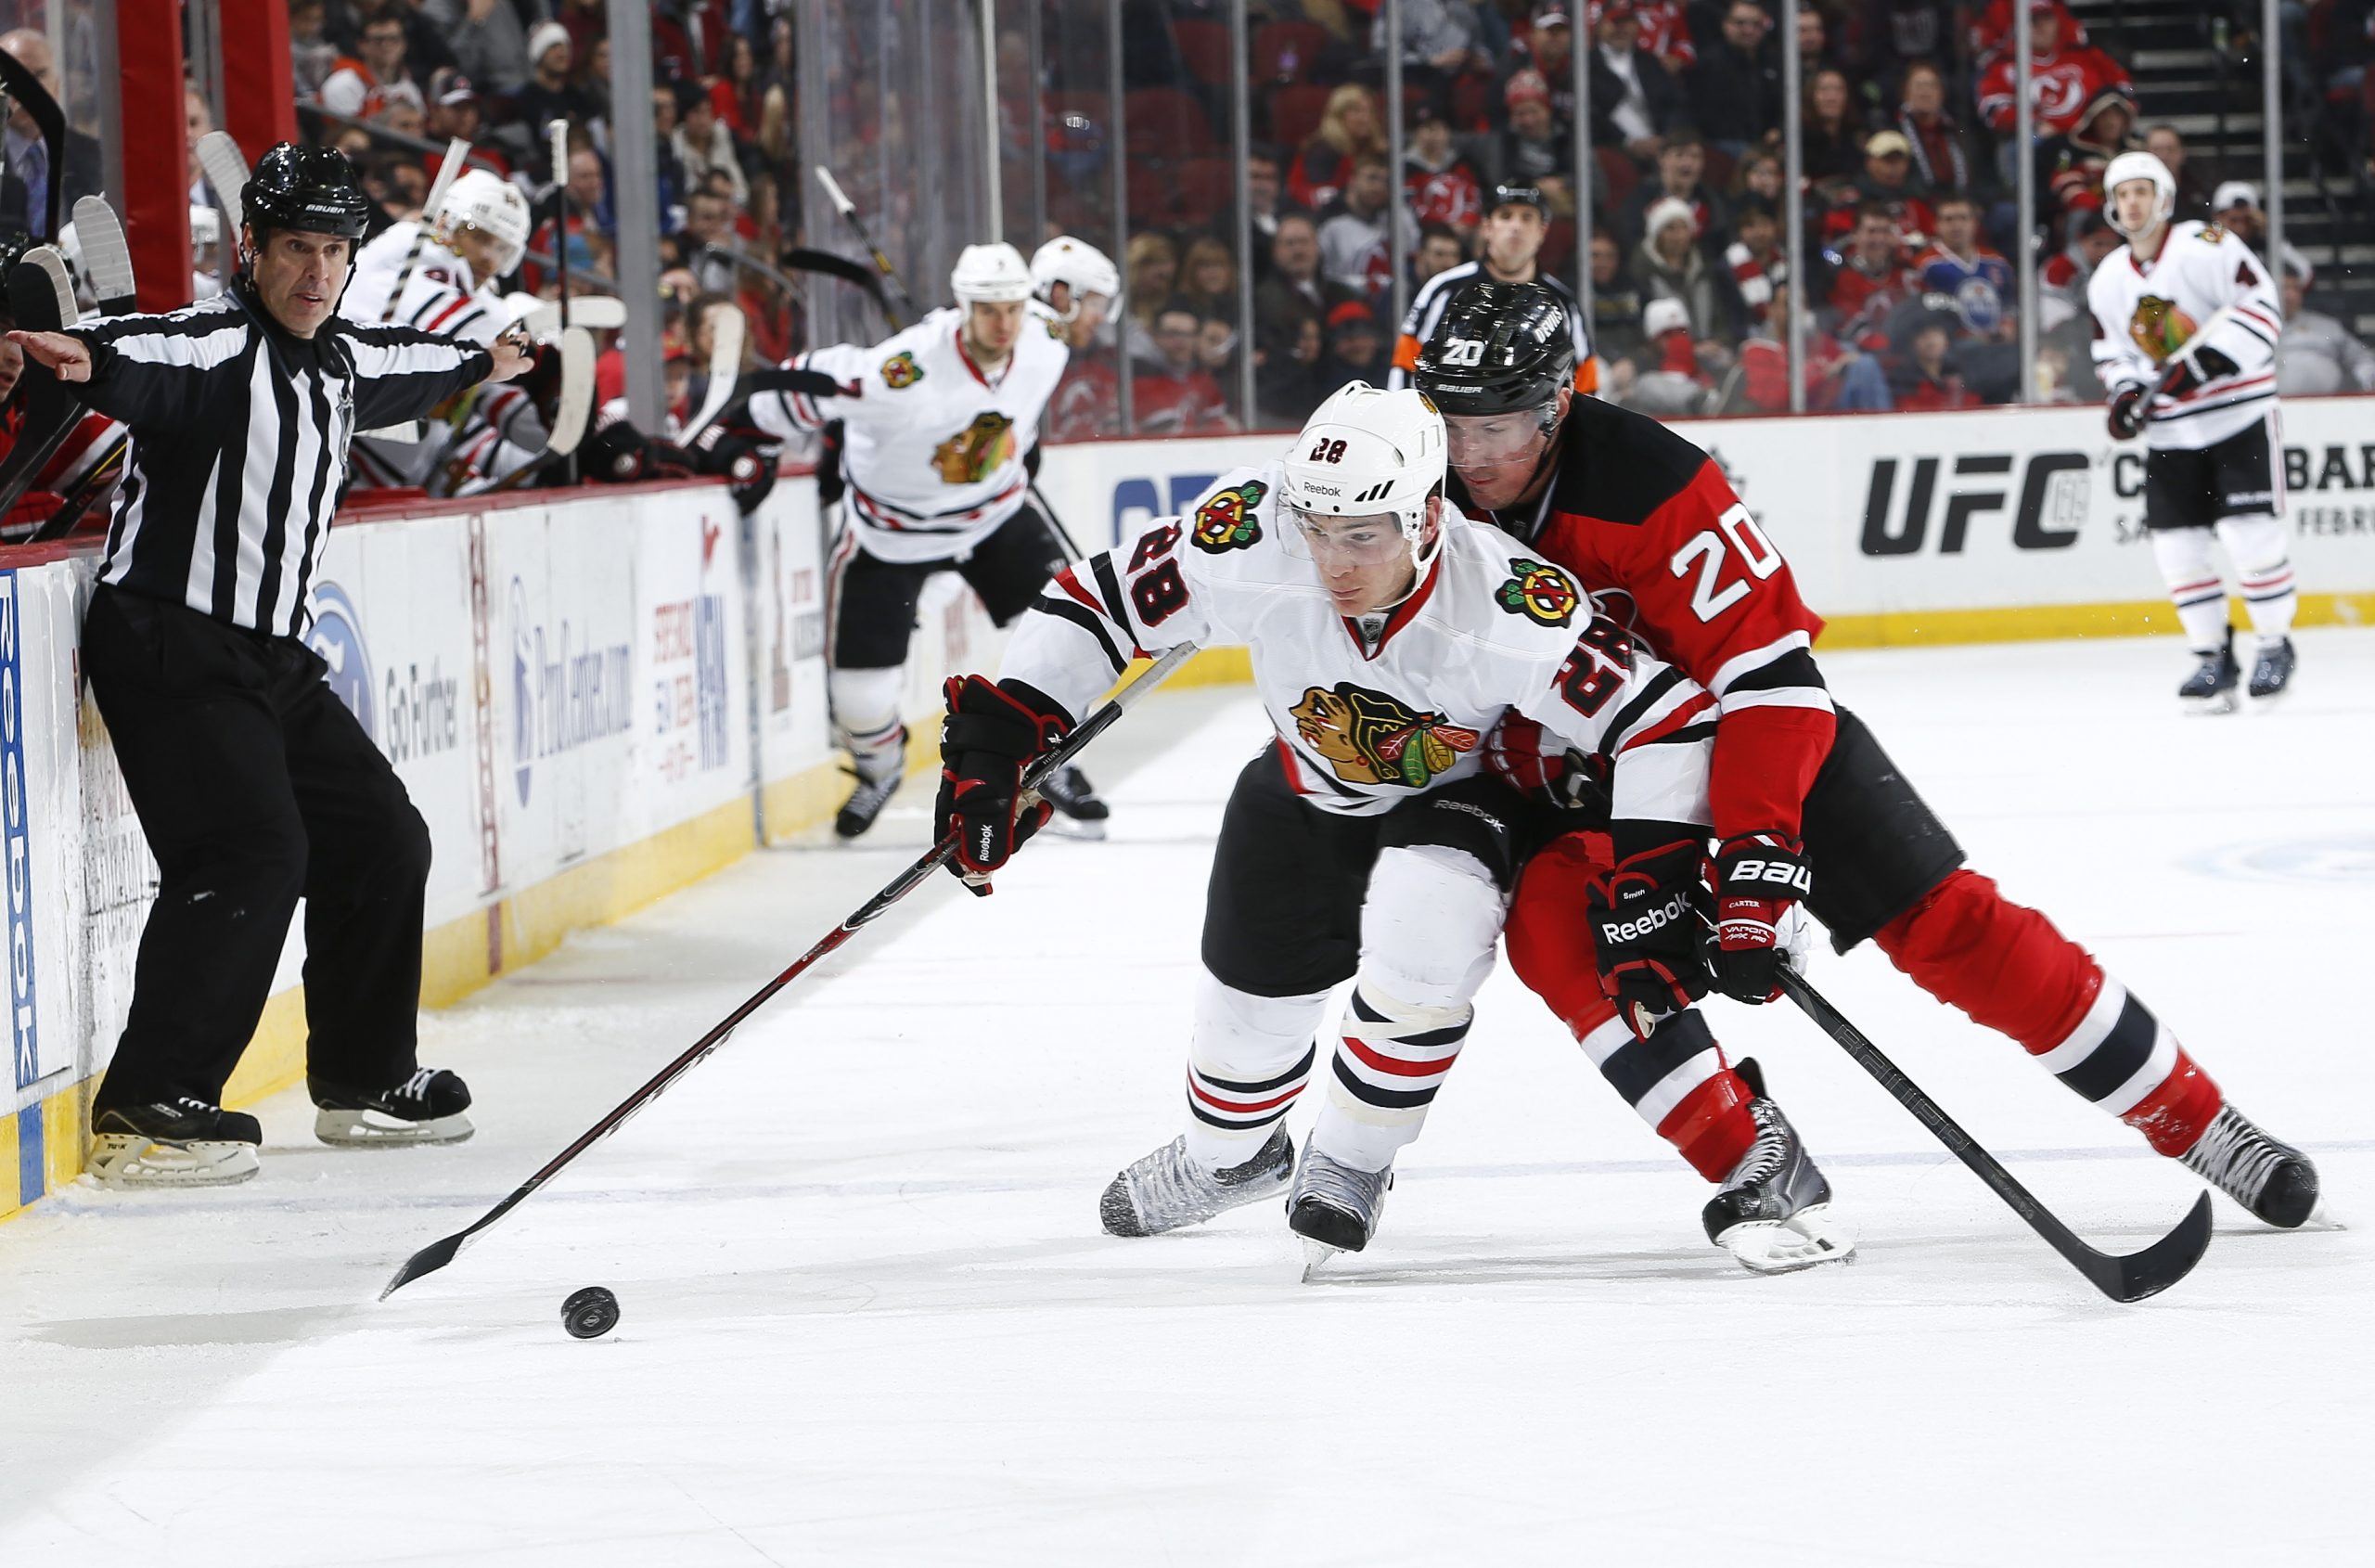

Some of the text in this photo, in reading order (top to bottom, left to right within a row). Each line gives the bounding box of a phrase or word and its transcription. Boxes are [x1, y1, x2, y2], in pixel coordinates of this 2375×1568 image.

[1441, 338, 1486, 366] 20
[1309, 437, 1348, 465] 28
[1304, 482, 1342, 497] Reebok
[1859, 453, 2090, 555] UFC
[2298, 508, 2375, 536] FEBR
[1670, 501, 1782, 623] 20
[1550, 616, 1636, 719] 28
[385, 667, 409, 765] Go
[0, 574, 35, 1086] Reebok
[1432, 799, 1506, 834] Reebok
[979, 824, 993, 862] Reebok
[1623, 889, 1646, 900] Smith
[1728, 900, 1760, 908] CARTER
[1601, 891, 1692, 945] Reebok
[1725, 926, 1770, 939] VAPOR
[1751, 935, 1767, 944] PRO
